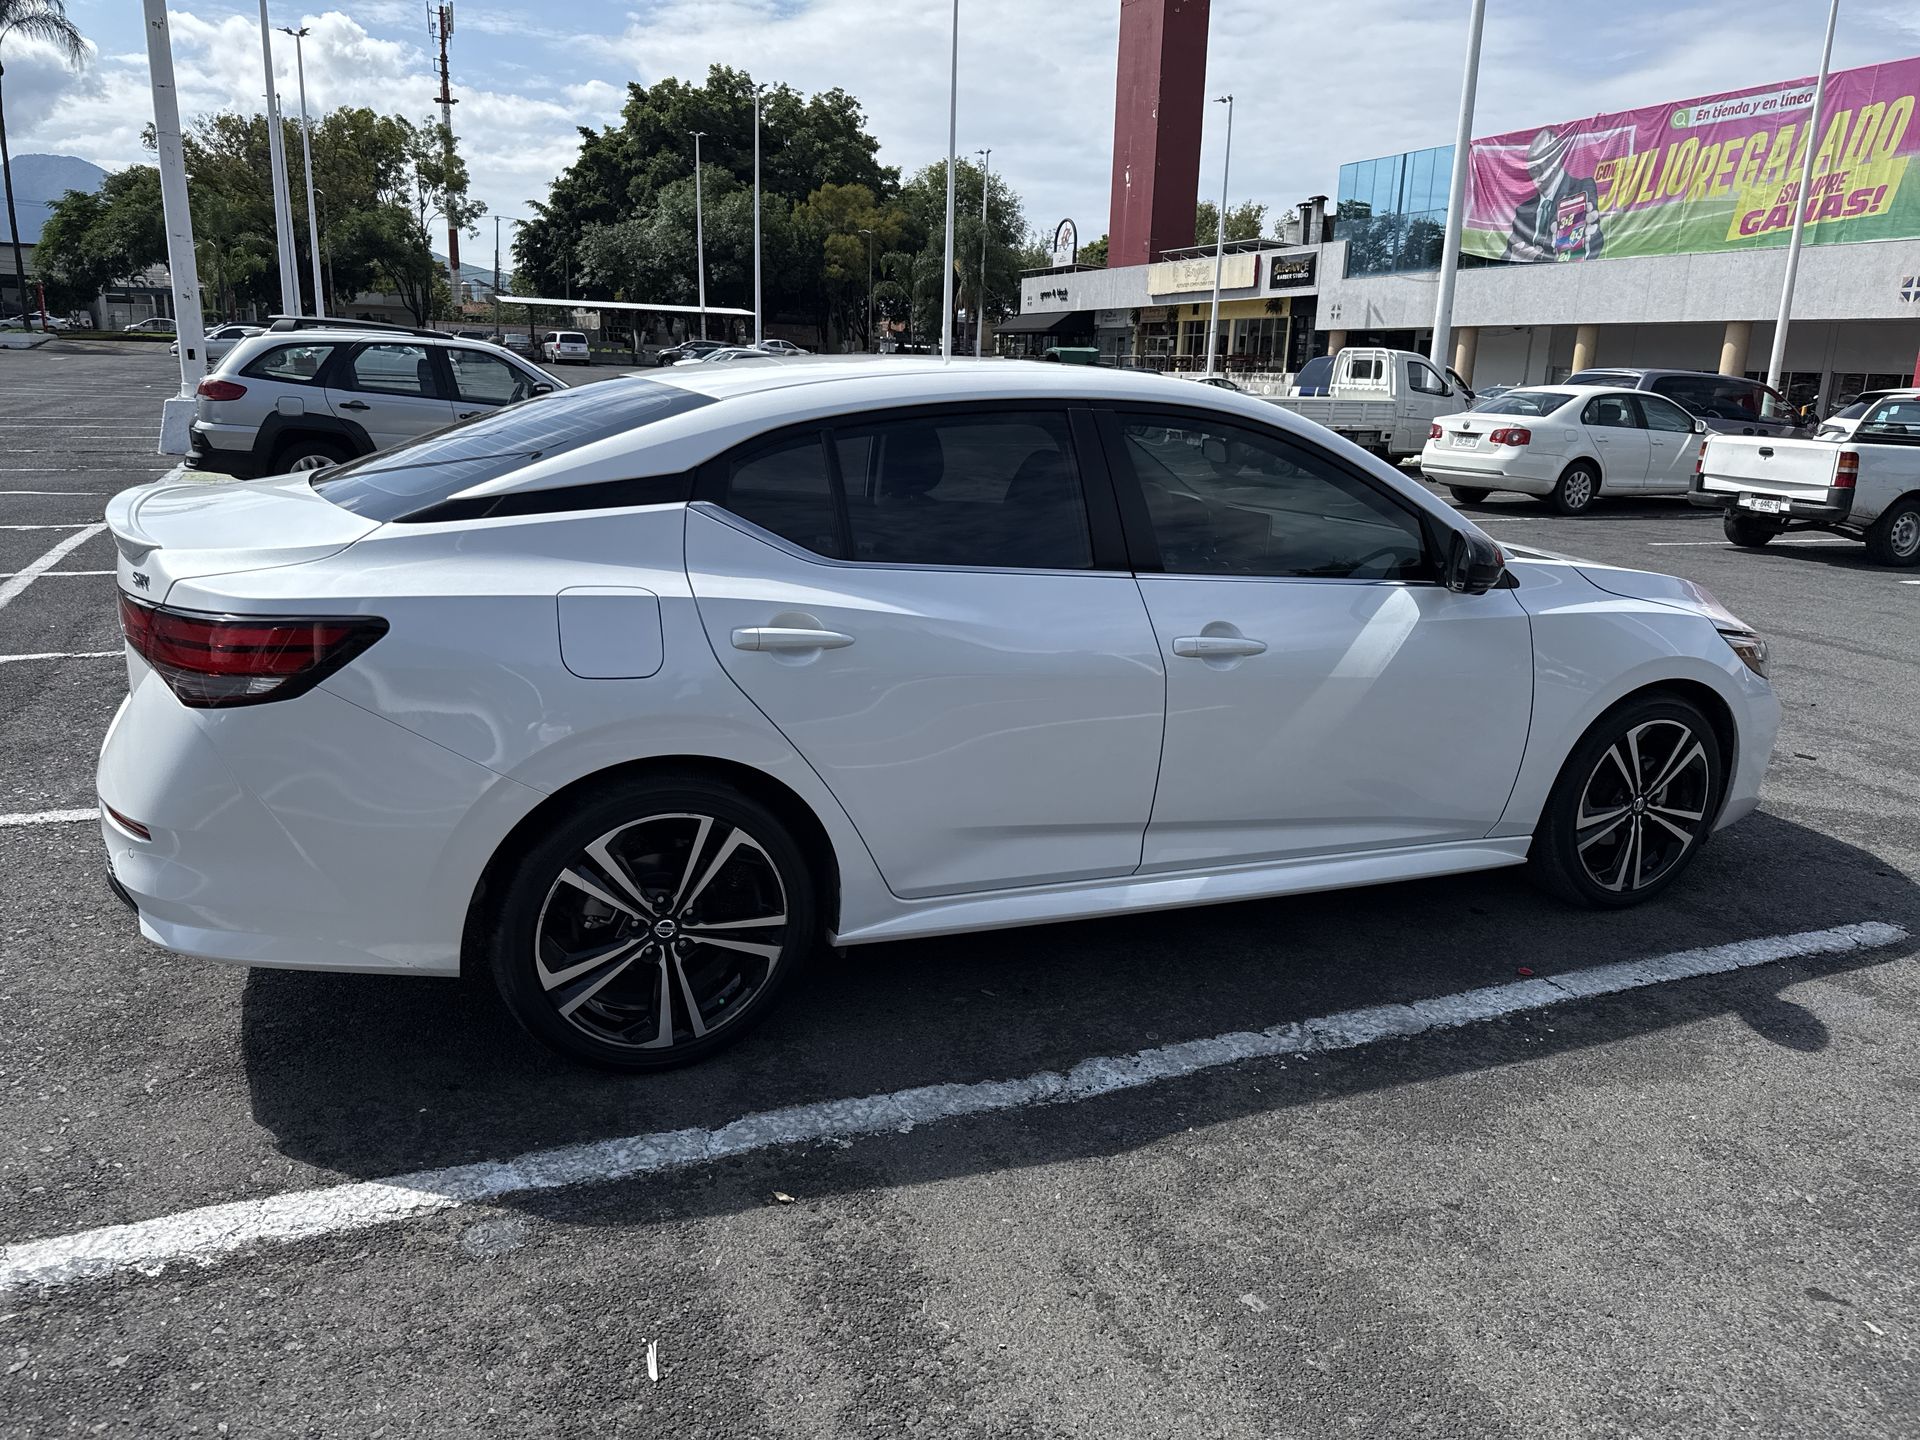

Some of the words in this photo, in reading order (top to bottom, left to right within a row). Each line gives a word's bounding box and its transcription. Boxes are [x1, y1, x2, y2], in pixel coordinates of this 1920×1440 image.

[1695, 109, 1711, 121] En
[1712, 102, 1750, 119] tienda
[1750, 101, 1760, 115] y
[1762, 98, 1777, 110] en
[1779, 92, 1813, 108] línea
[1739, 184, 1888, 236] GANAS!
